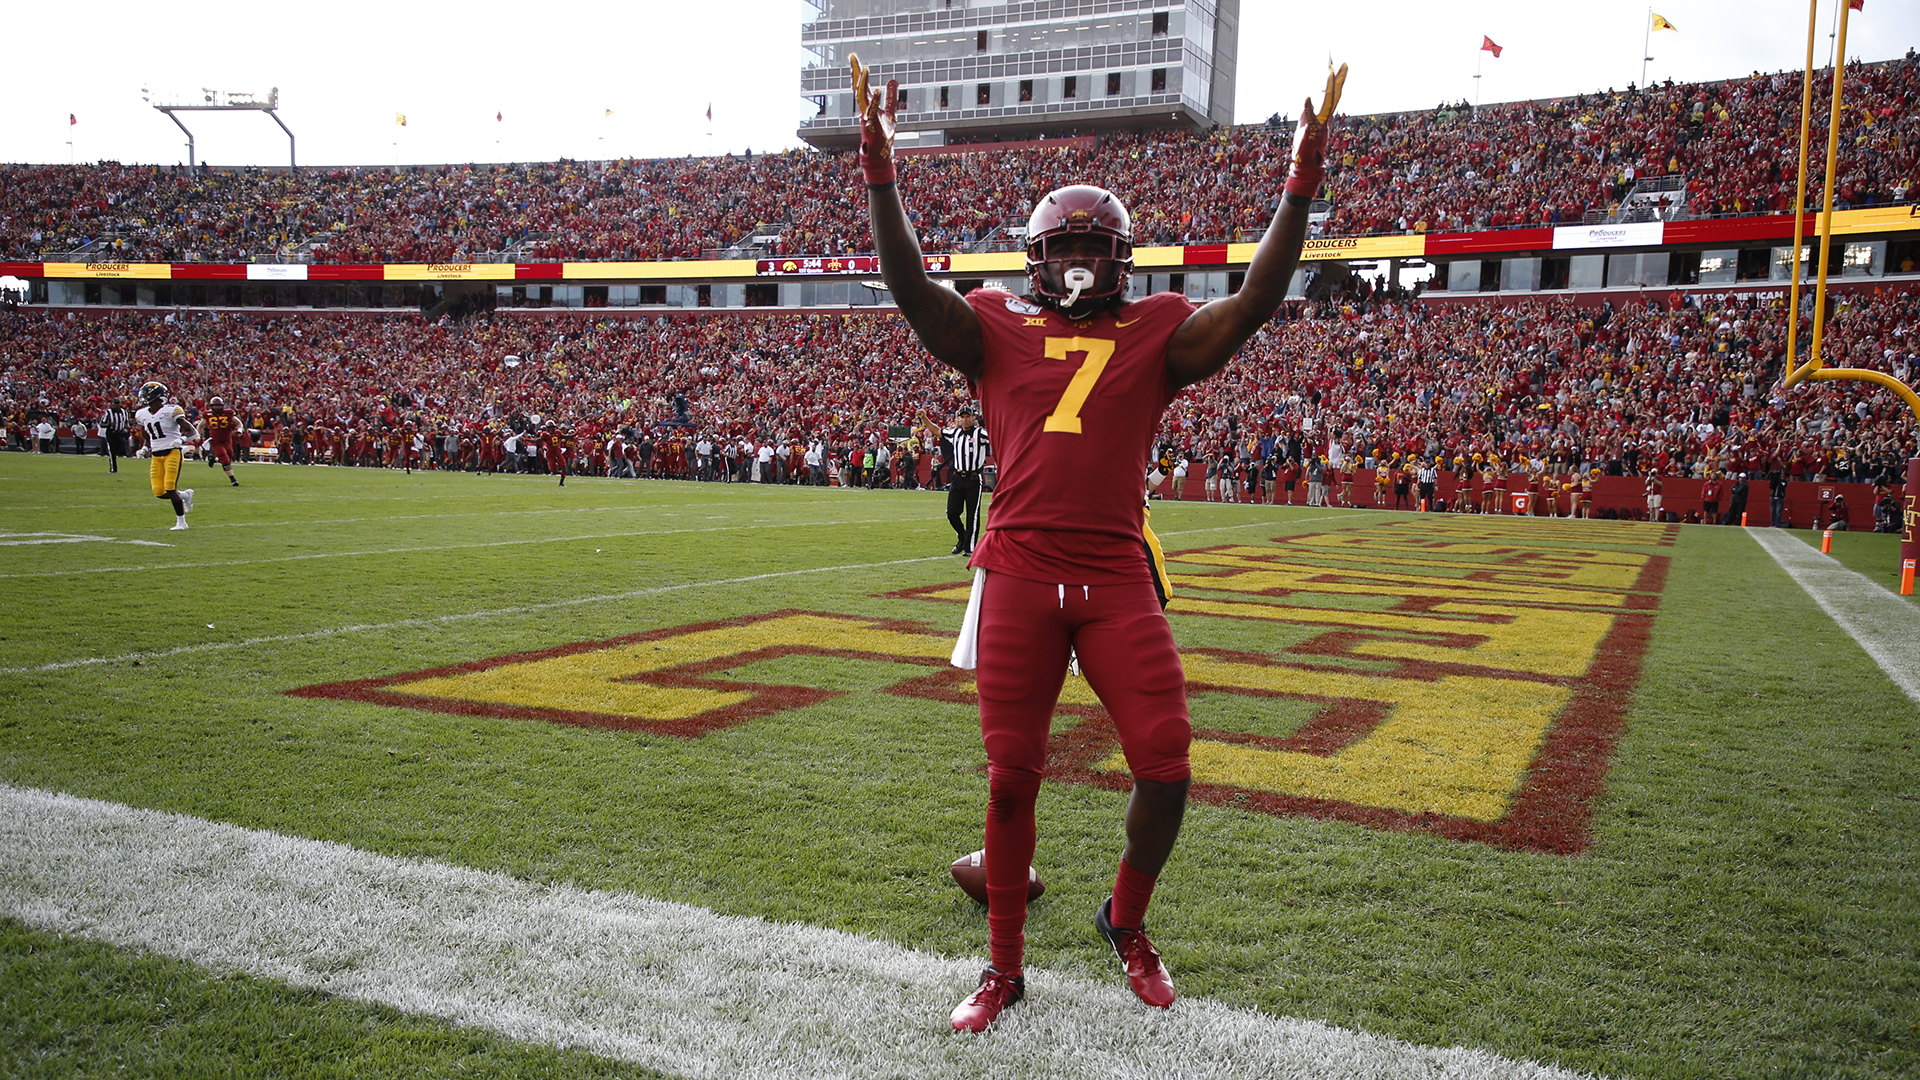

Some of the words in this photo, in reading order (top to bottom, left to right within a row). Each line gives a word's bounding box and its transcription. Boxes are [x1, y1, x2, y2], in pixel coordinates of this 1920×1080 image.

[1301, 239, 1358, 249] RODUCERS
[768, 261, 775, 272] 3
[803, 259, 822, 268] 5:44
[848, 260, 855, 270] 0
[930, 263, 942, 271] 49
[1022, 316, 1048, 327] XII
[1043, 336, 1116, 434] 7
[209, 416, 228, 429] 63
[147, 421, 166, 440] 11
[1515, 498, 1526, 509] G
